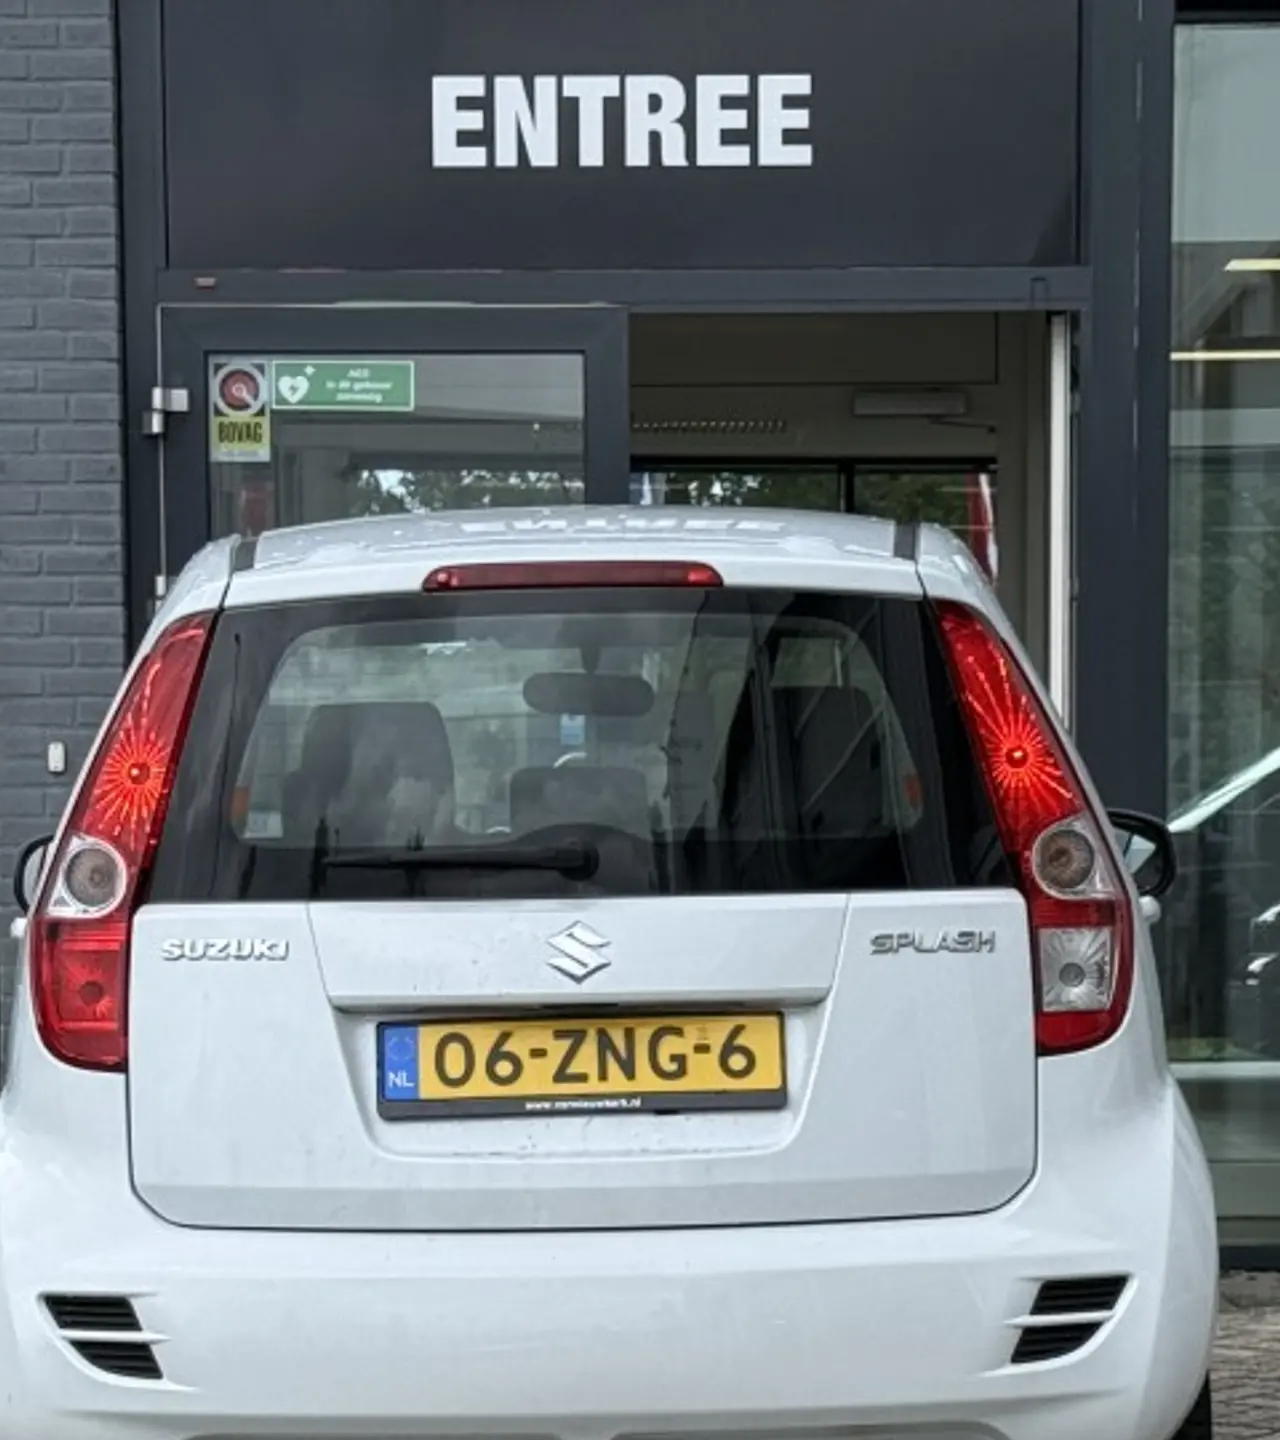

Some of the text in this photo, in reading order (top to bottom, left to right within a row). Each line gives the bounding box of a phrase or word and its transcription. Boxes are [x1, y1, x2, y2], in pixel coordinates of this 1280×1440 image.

[432, 74, 813, 167] ENTREE
[218, 421, 263, 443] BOVAG
[161, 937, 290, 962] SUZUKI
[870, 930, 996, 956] SPLASH
[434, 1024, 757, 1088] 06-ZNG-6
[387, 1072, 416, 1088] NL
